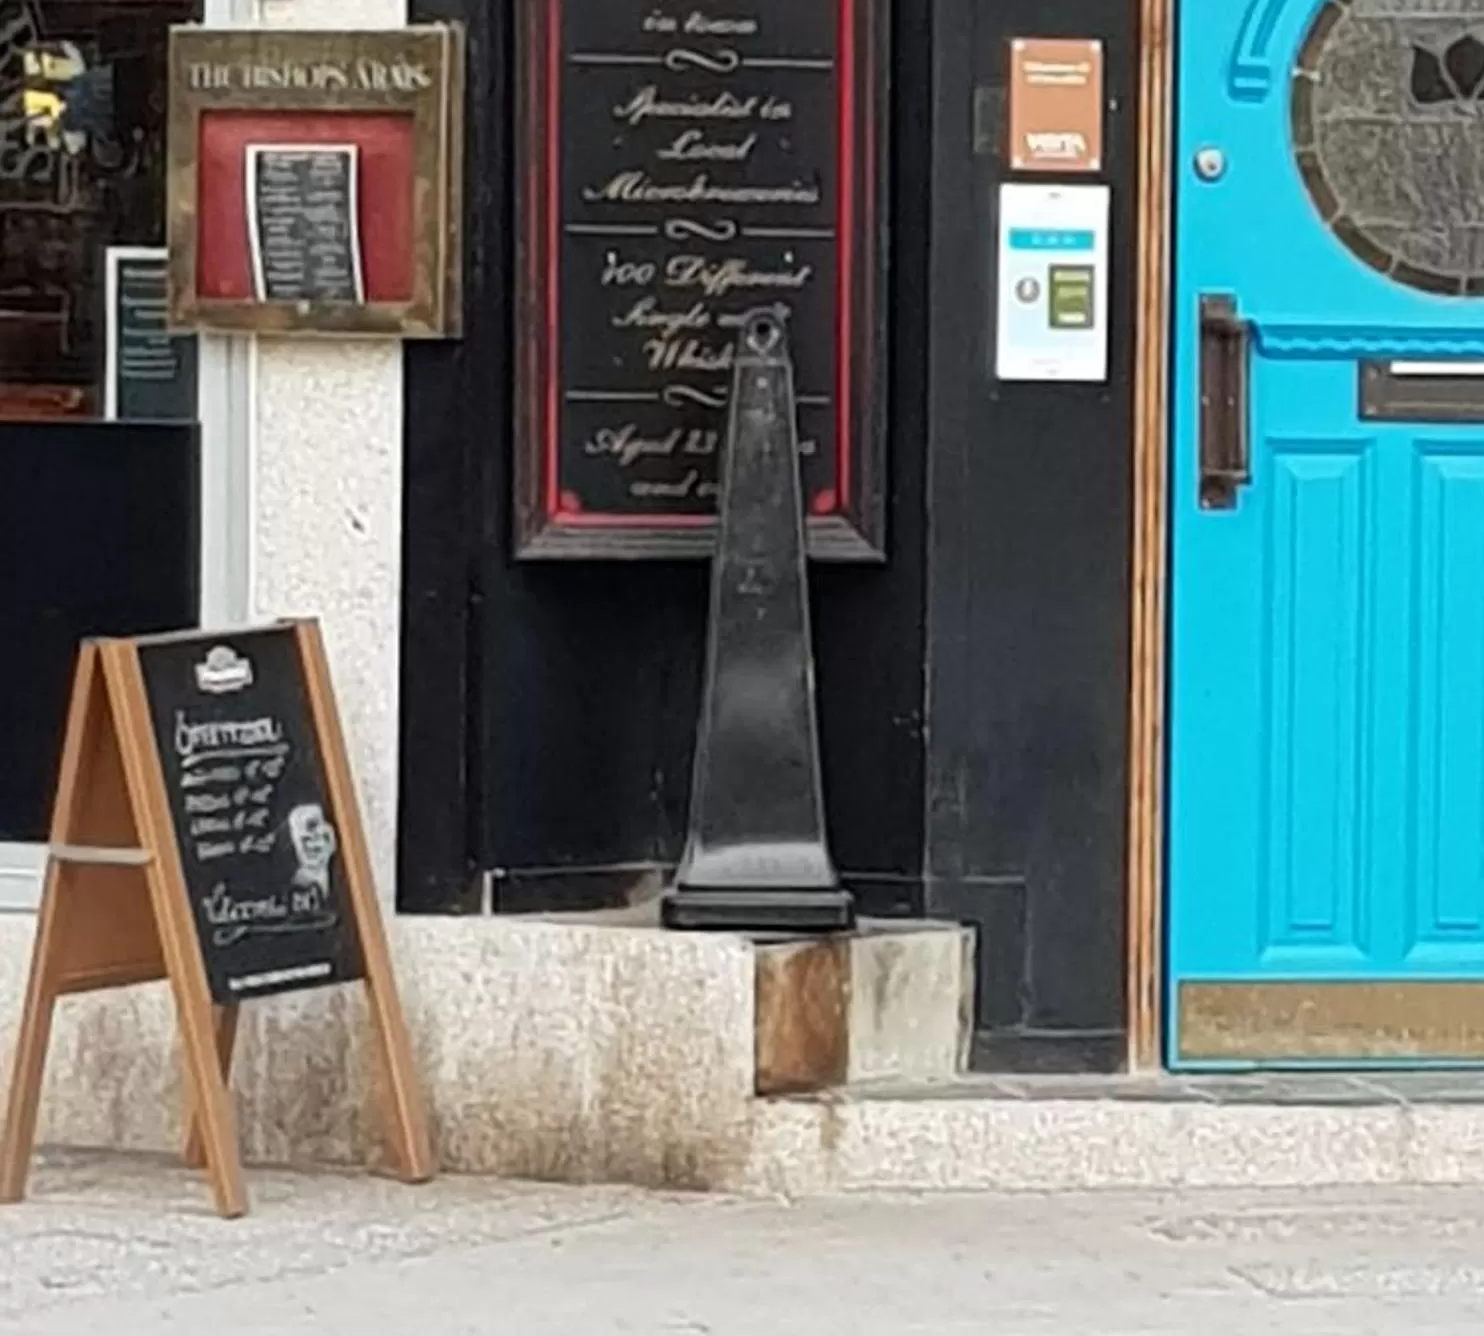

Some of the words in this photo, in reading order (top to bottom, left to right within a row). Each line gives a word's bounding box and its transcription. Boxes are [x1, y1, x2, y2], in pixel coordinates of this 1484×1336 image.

[642, 9, 677, 31] in
[684, 11, 757, 33] town
[612, 85, 757, 124] Specialist
[760, 95, 792, 119] in
[656, 130, 757, 160] Local
[664, 254, 812, 295] Different
[612, 297, 710, 337] Single
[629, 468, 698, 496] and
